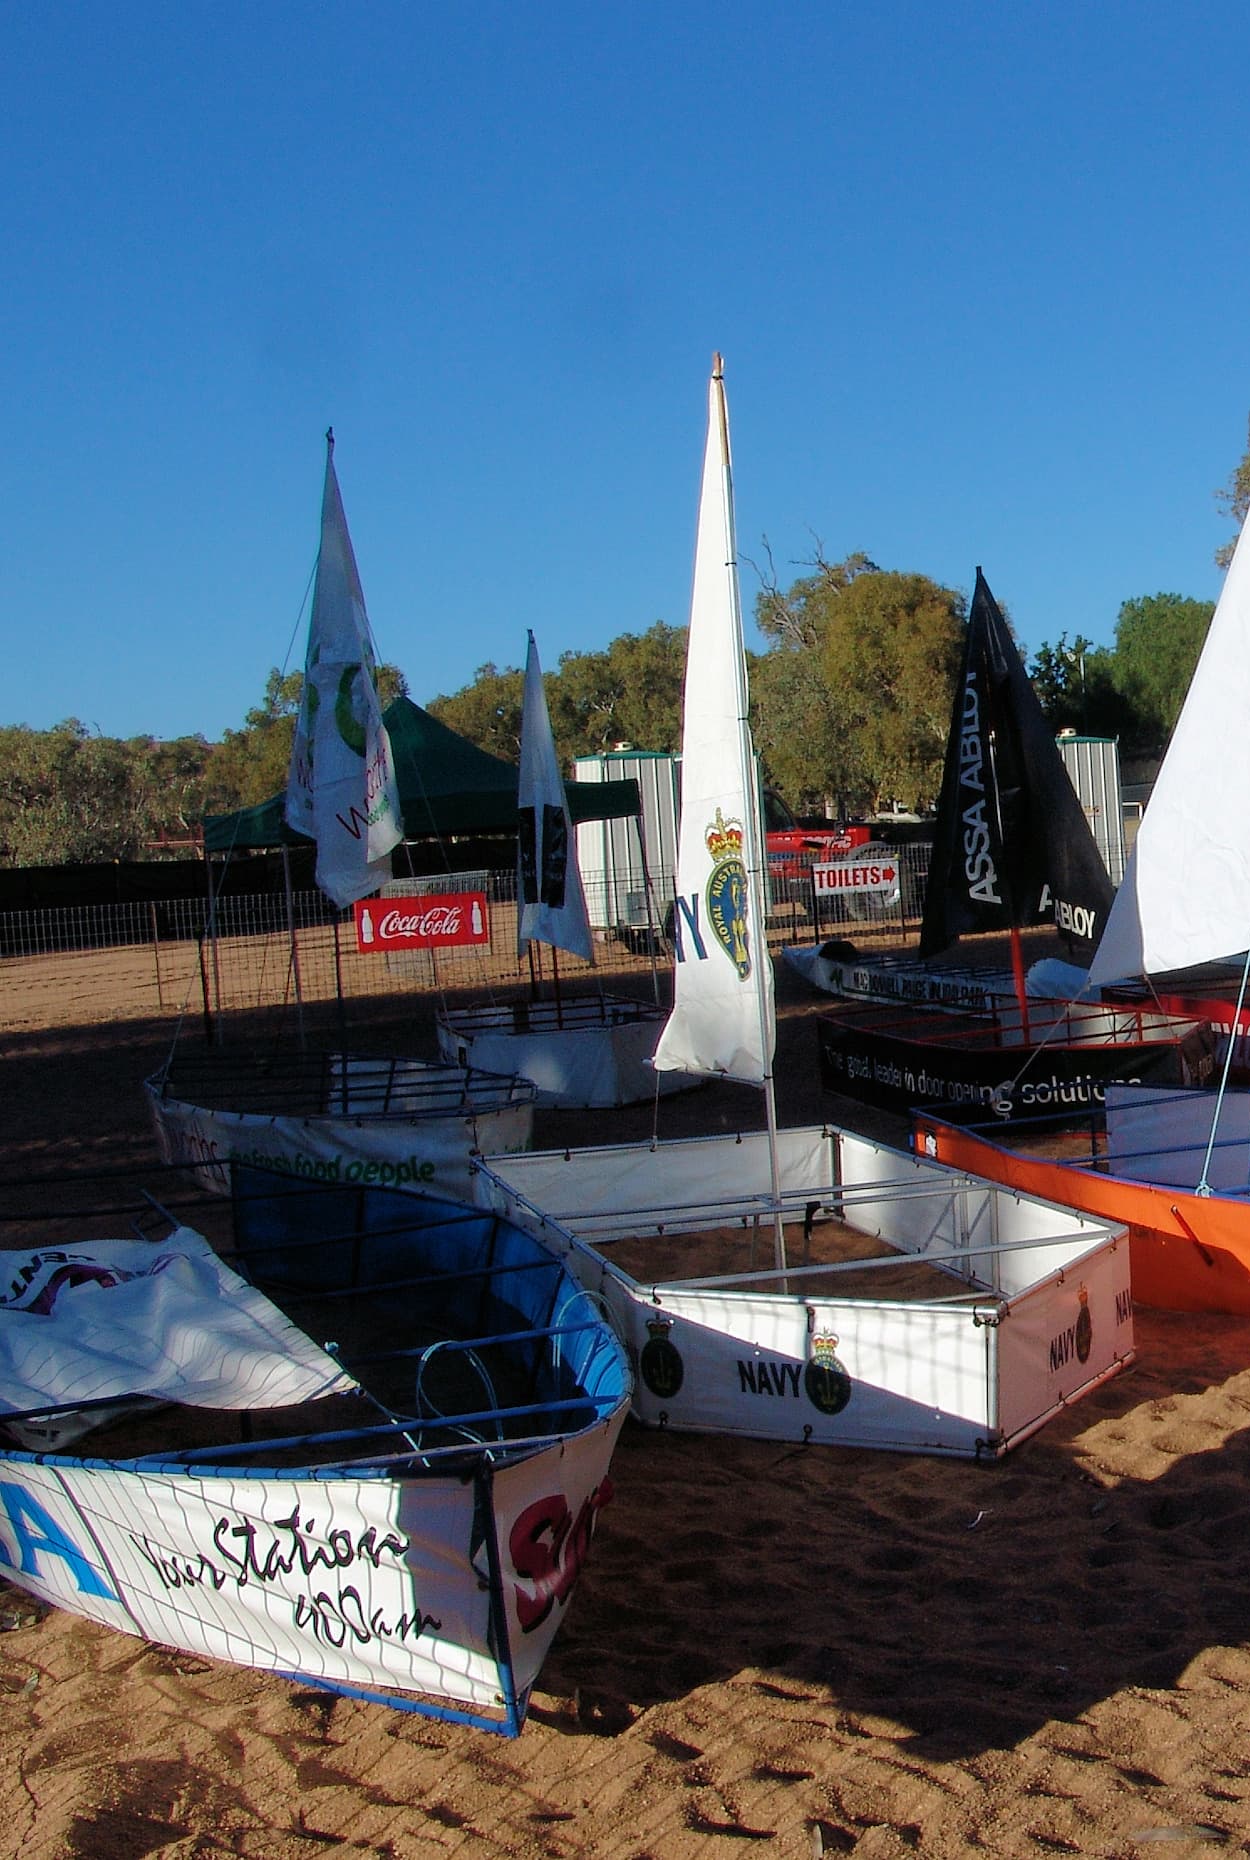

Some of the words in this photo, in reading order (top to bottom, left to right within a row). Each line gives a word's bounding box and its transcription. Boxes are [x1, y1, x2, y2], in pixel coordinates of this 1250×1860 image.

[961, 799, 1002, 904] ASSA
[815, 866, 881, 889] TOILETS
[379, 906, 463, 939] Coca-Cola
[712, 906, 732, 944] ROYAL
[1055, 899, 1096, 939] ABLOY
[904, 1067, 916, 1093] in
[917, 1069, 945, 1097] door
[1049, 1324, 1076, 1374] NAVY
[736, 1360, 802, 1398] NAVY
